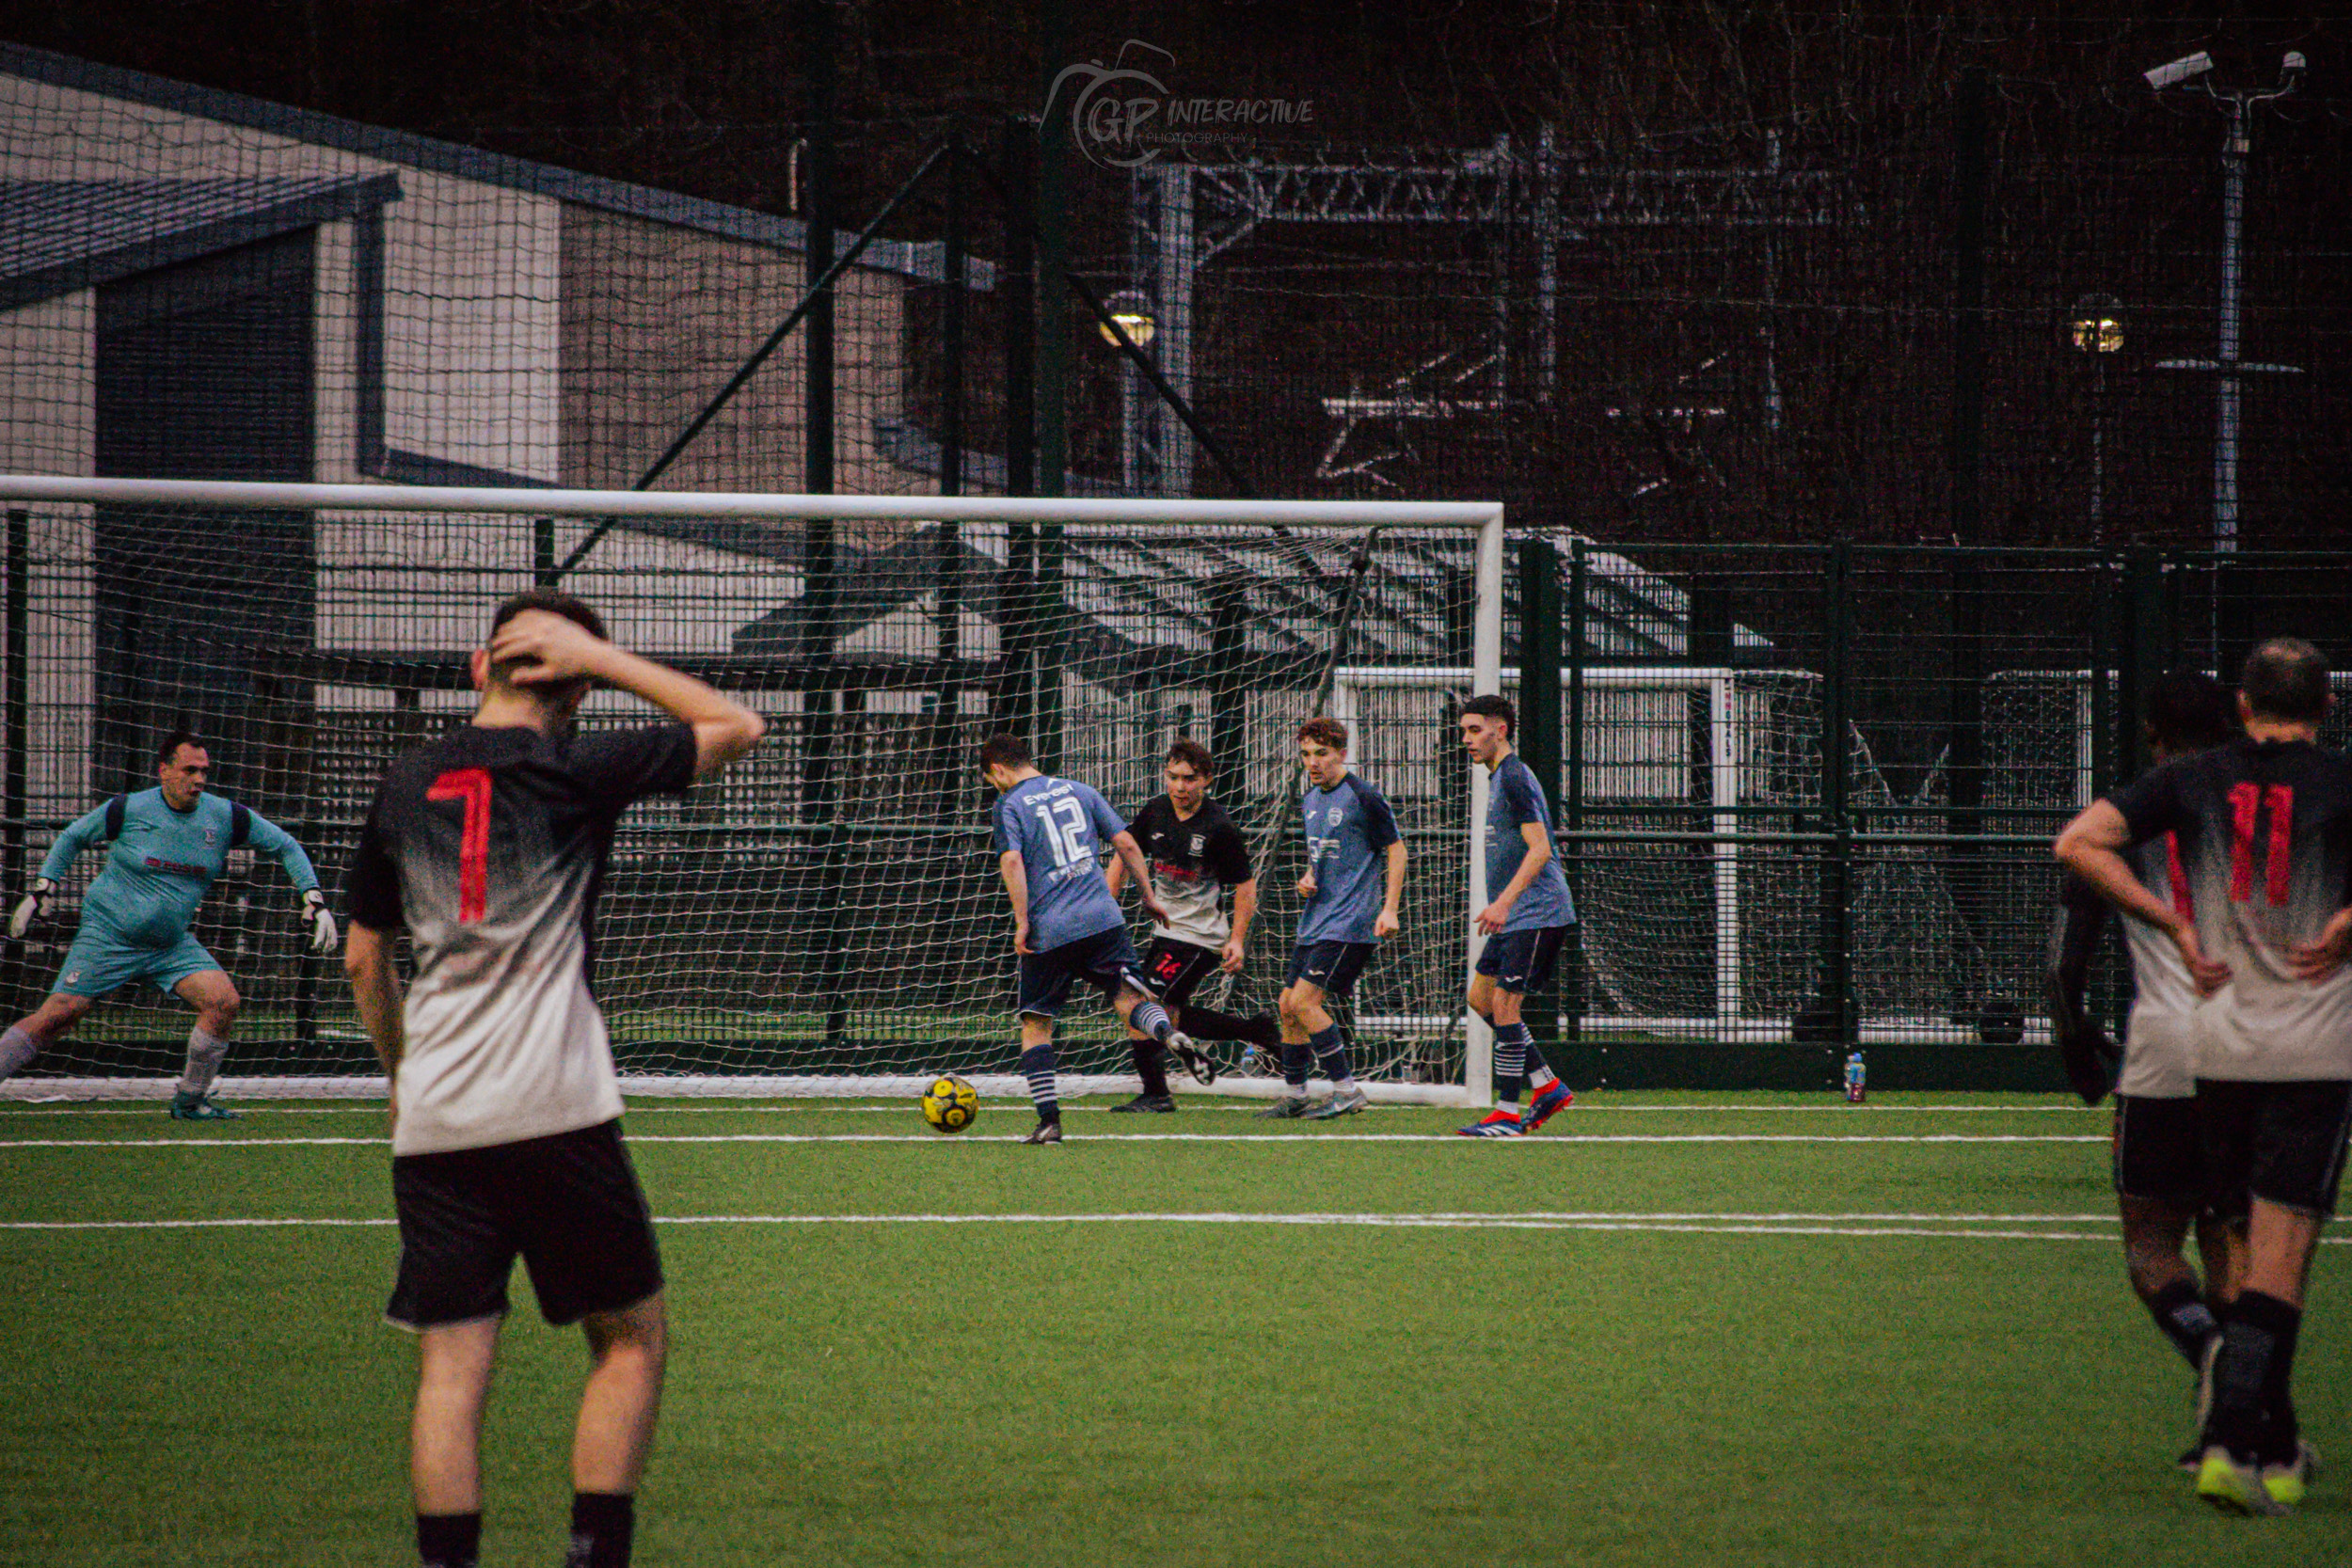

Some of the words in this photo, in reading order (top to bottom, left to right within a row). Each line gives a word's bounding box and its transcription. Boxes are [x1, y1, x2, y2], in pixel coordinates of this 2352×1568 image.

[1023, 784, 1073, 805] Everest
[427, 768, 491, 922] 7
[1036, 797, 1092, 867] 12
[2227, 782, 2294, 906] 11
[1155, 953, 1181, 979] 16
